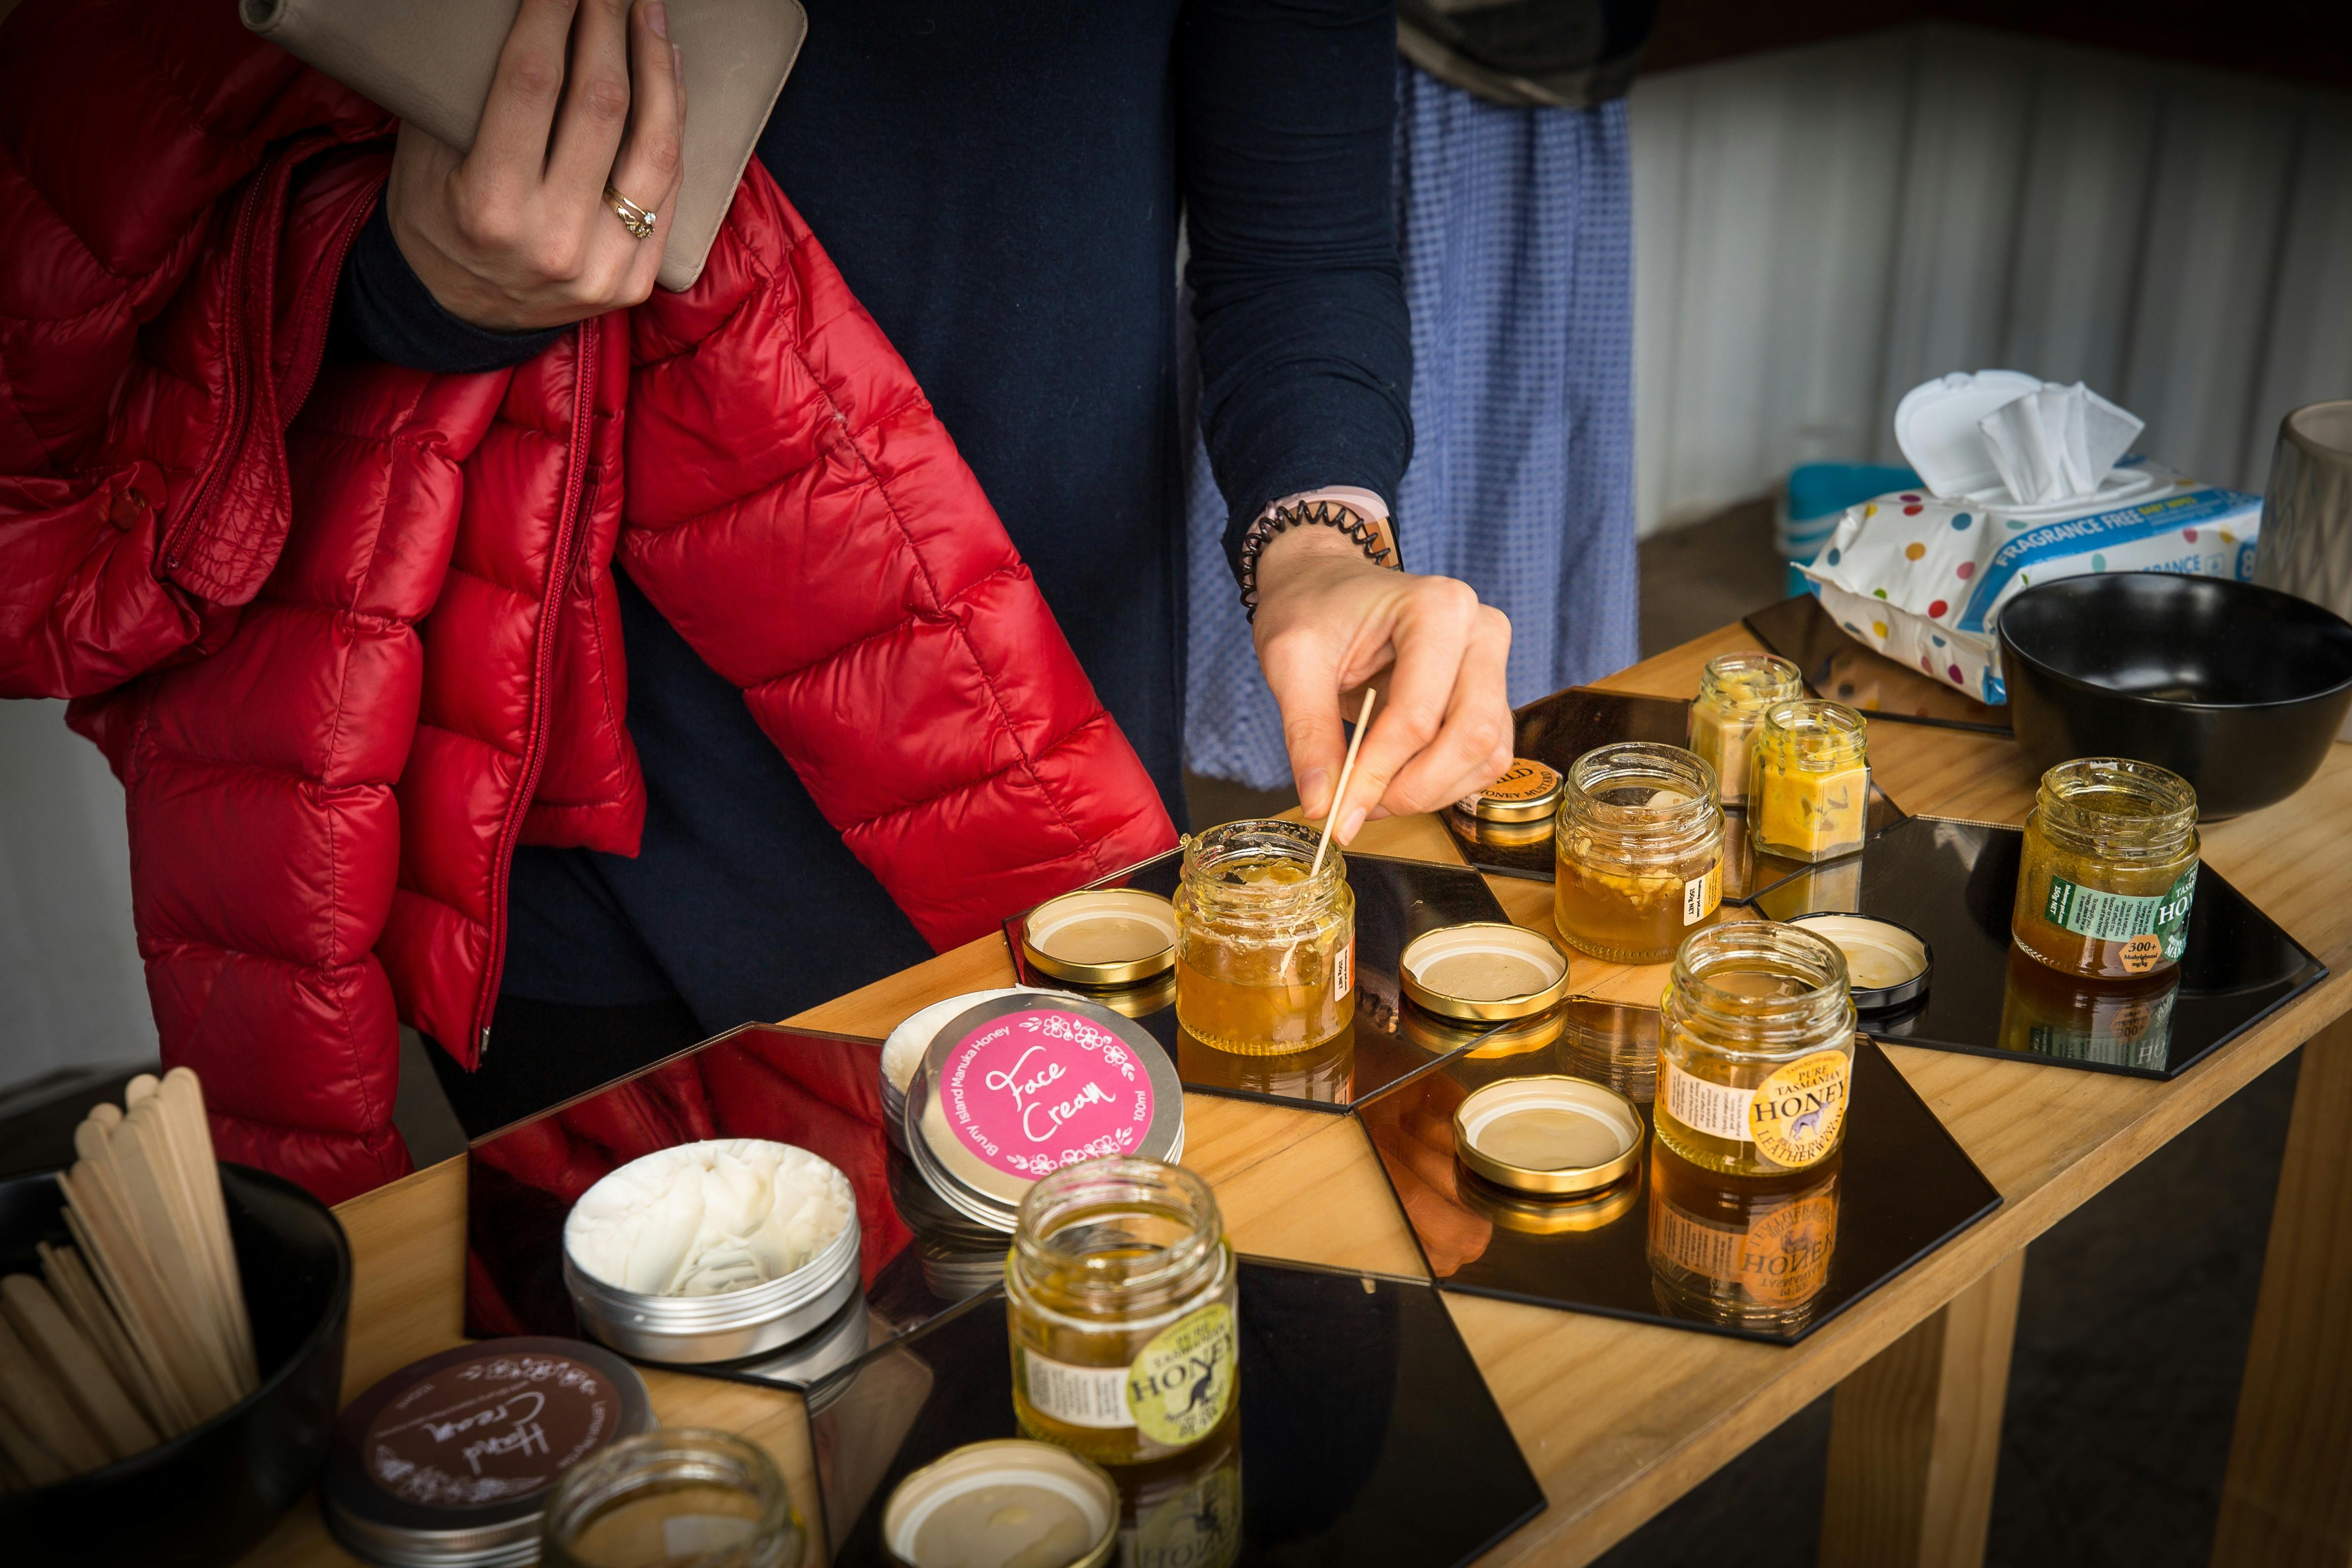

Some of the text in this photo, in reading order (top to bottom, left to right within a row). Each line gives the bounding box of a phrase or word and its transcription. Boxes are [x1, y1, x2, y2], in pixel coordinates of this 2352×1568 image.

[1996, 516, 2104, 567] FRAGRANCE
[2100, 508, 2145, 530] FREE
[1496, 768, 1533, 784] ILD
[1524, 771, 1553, 796] MUSTARD
[2052, 886, 2061, 901] 150g
[2101, 917, 2110, 937] nutritional
[2124, 952, 2158, 961] Methylglyoxal
[2128, 942, 2157, 952] 300+
[985, 1045, 1067, 1113] Face
[1777, 1069, 1842, 1095] TASMANIAN
[1799, 1065, 1828, 1081] PURE
[950, 1025, 1010, 1157] Bruny Island Manuka Honey
[1133, 1090, 1147, 1121] 100ml
[1754, 1078, 1848, 1122] HONEY
[1023, 1082, 1117, 1142] Cream
[1130, 1331, 1233, 1403] HONEY
[421, 1391, 545, 1444] Cream
[462, 1421, 551, 1476] Hand
